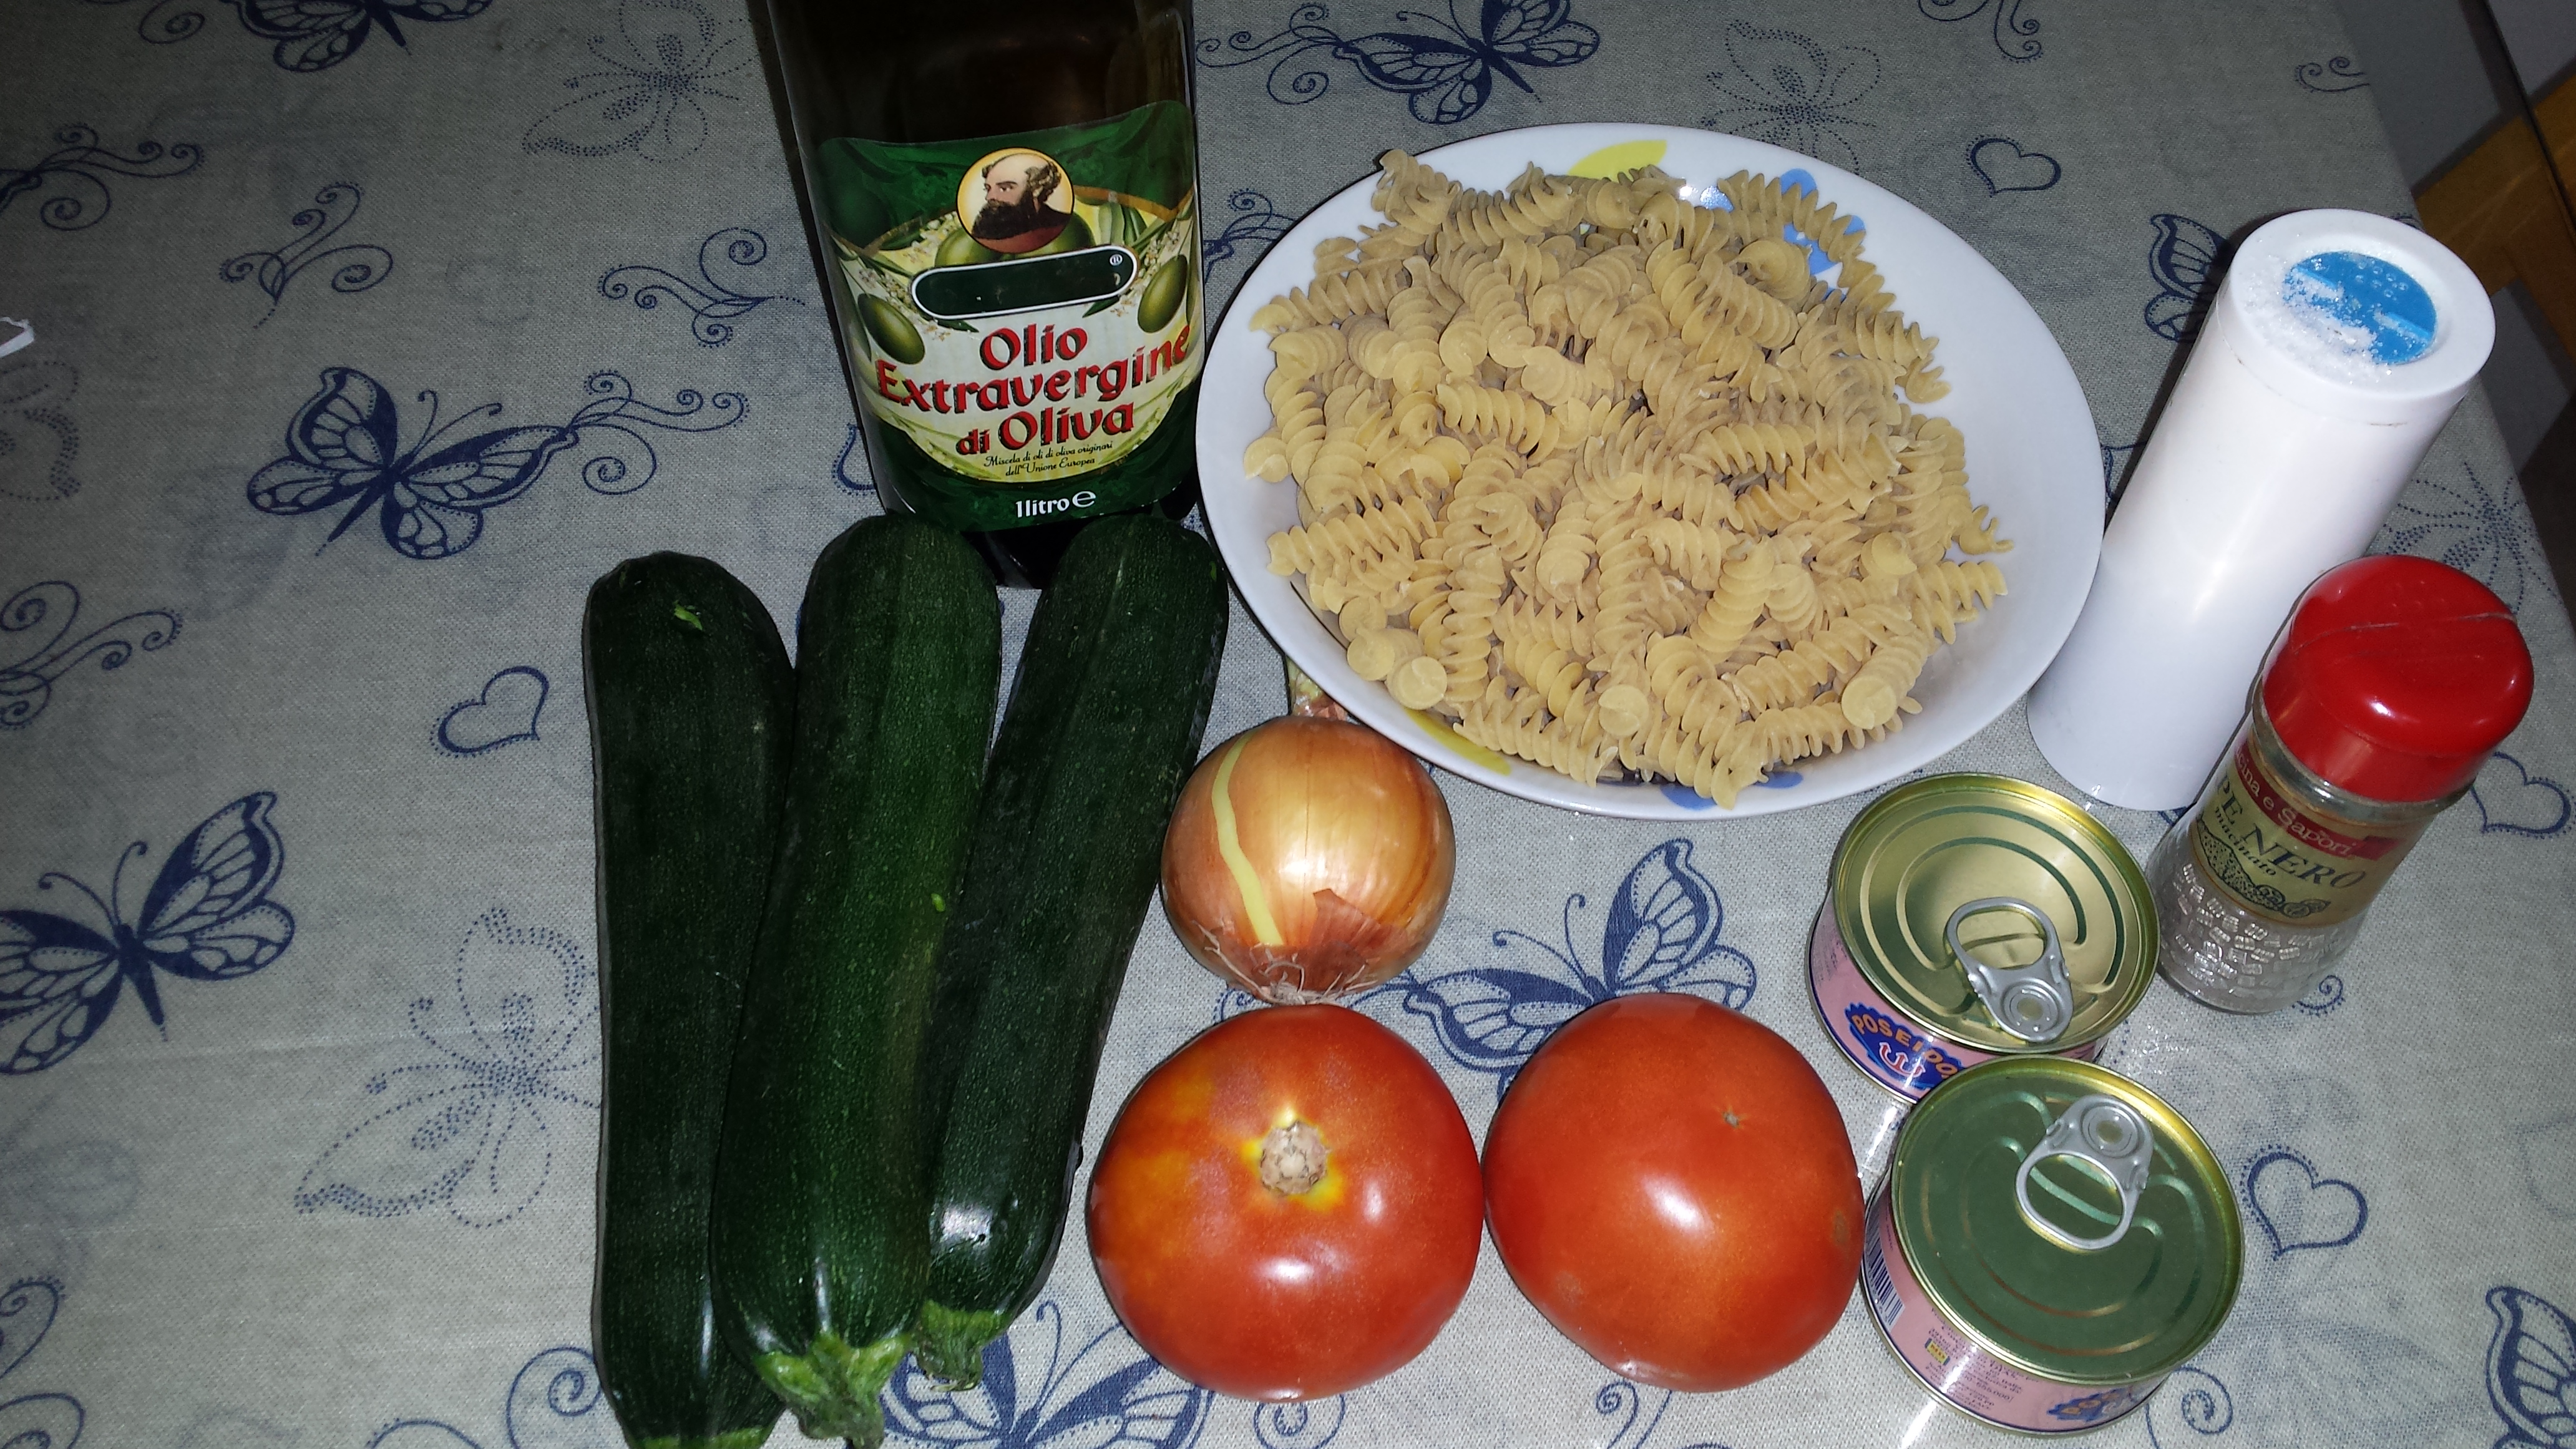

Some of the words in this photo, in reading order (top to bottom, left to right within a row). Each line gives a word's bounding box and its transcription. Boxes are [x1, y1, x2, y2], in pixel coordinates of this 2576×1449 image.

[875, 325, 1189, 414] Extravergine
[980, 324, 1088, 370] Olio
[956, 428, 990, 455] di
[998, 402, 1134, 451] Oliva
[983, 453, 1021, 467] Miscela
[1022, 451, 1031, 462] di
[1033, 449, 1043, 460] oli
[1046, 447, 1053, 459] di
[1055, 446, 1076, 457] oliva
[1077, 441, 1113, 454] originari
[1059, 457, 1095, 468] Europea
[2215, 806, 2277, 876] macinato
[2241, 822, 2366, 889] NERO
[2263, 796, 2275, 810] e
[2278, 807, 2357, 856] Sapori
[1851, 1013, 1959, 1080] POSEIDO
